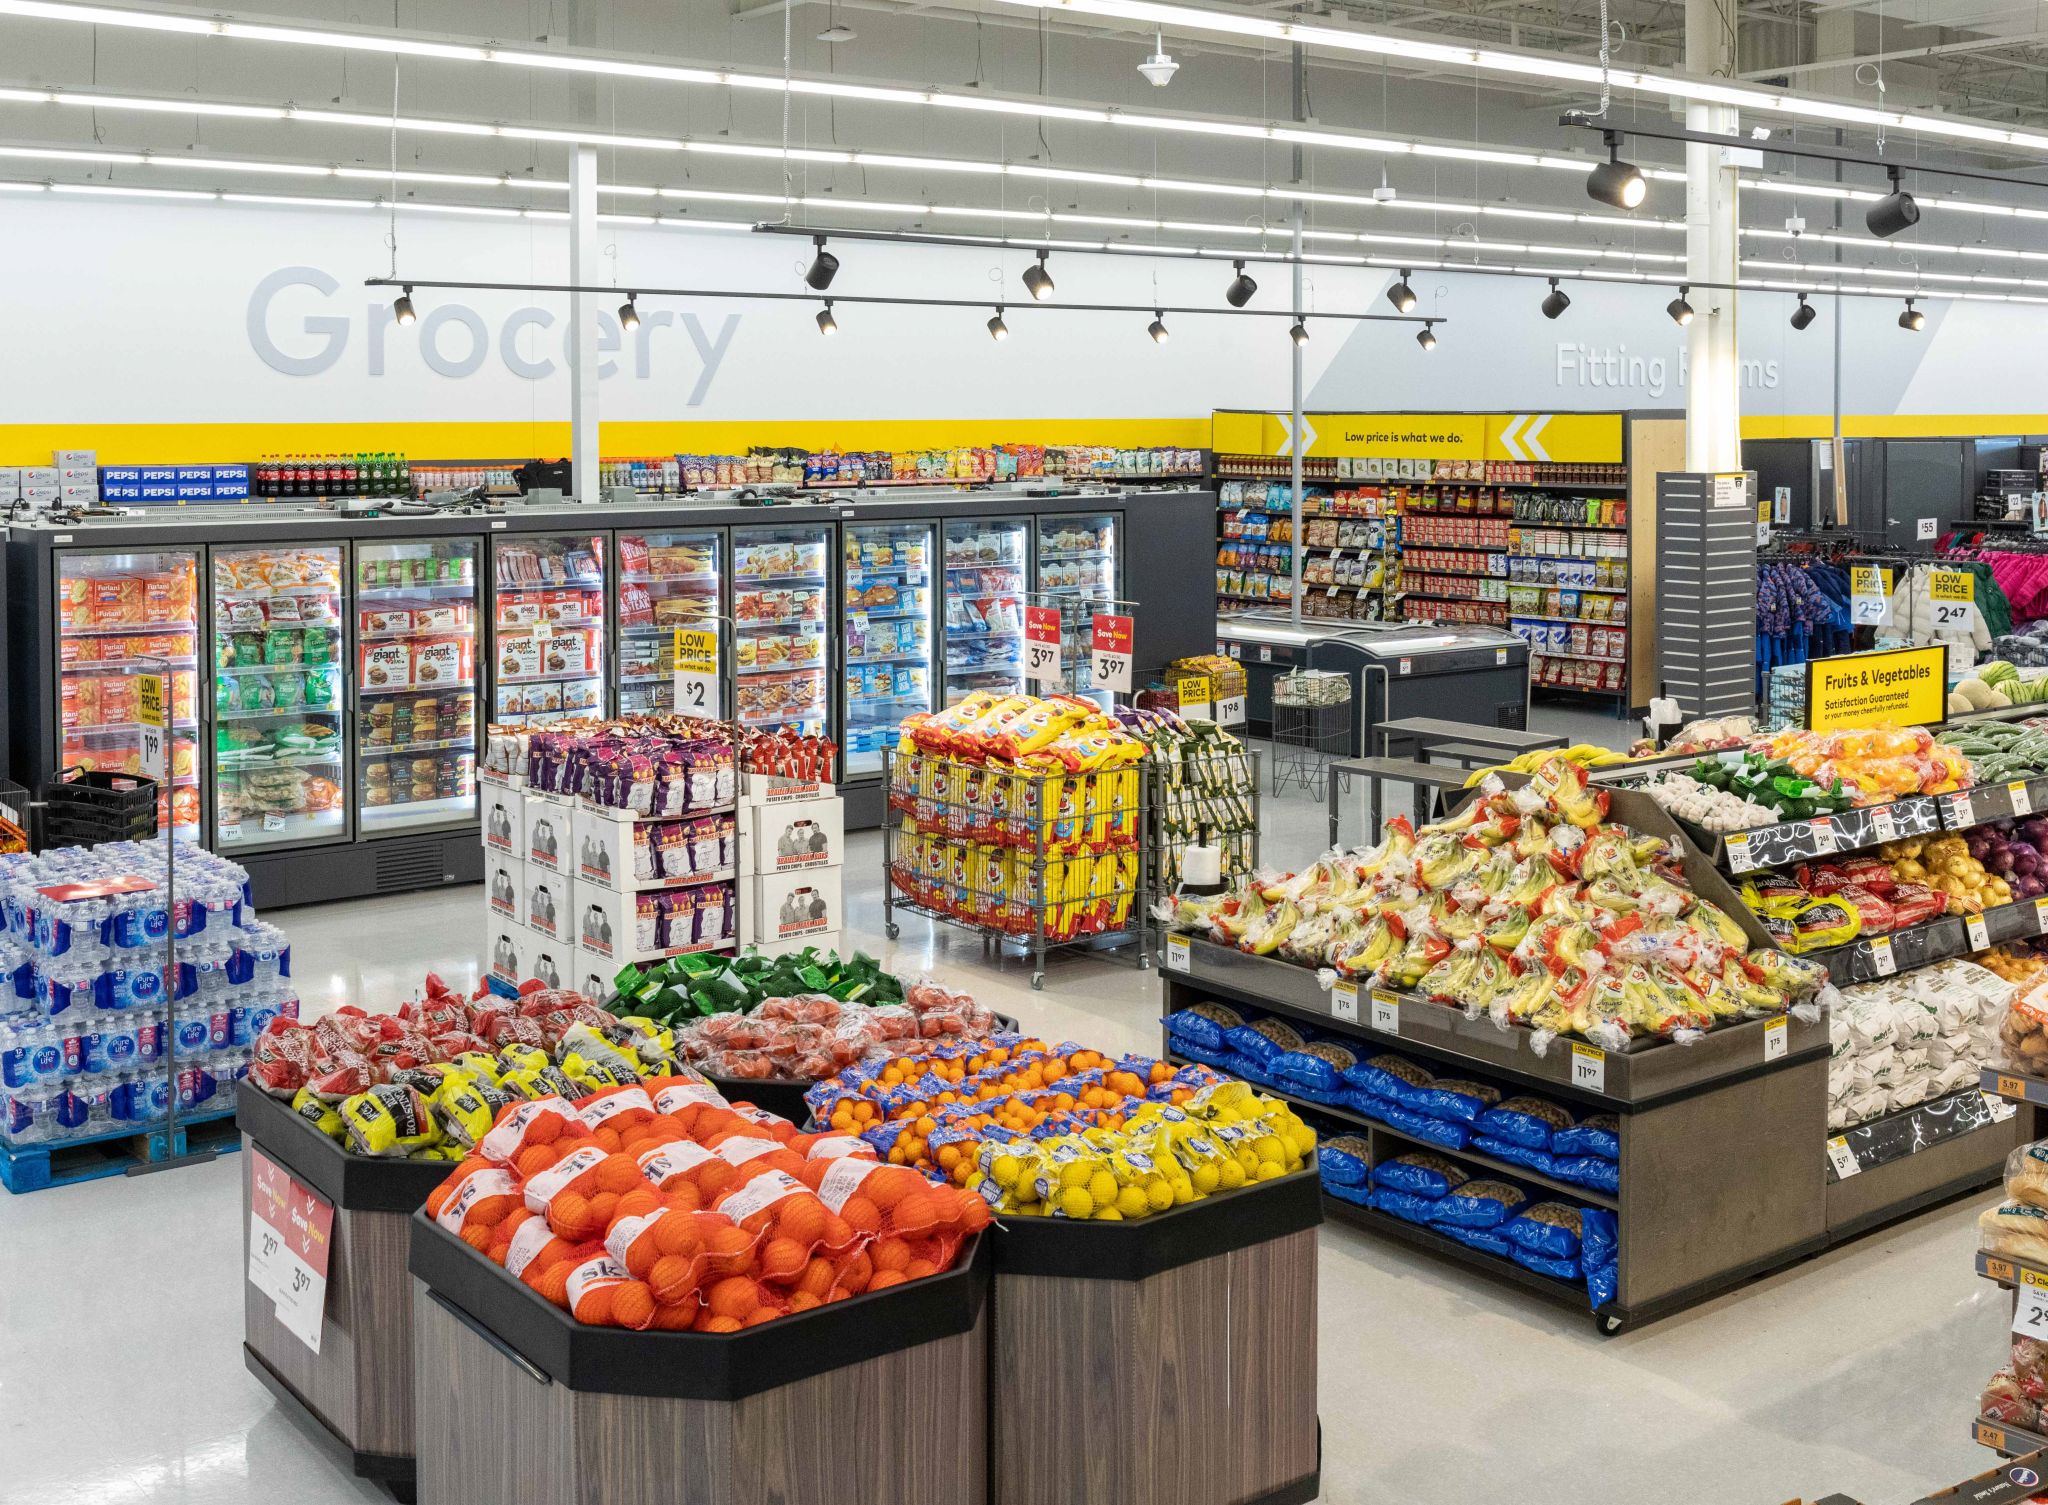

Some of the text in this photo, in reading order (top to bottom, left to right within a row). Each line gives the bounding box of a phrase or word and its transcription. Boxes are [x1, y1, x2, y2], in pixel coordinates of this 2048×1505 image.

[1556, 343, 1666, 397] Fitting
[1345, 431, 1463, 444] Low price is what we do.
[106, 471, 139, 480] PEPSI
[143, 471, 175, 480] PEPSI
[179, 471, 211, 479] PEPSI
[216, 470, 247, 479] PEPSI
[106, 488, 139, 497] PEPSI
[143, 488, 175, 497] PEPSI
[179, 487, 211, 496] PEPSI
[216, 486, 247, 496] PEPSI
[1921, 522, 1934, 533] $55
[1935, 574, 1962, 584] LOW
[1935, 584, 1968, 594] PRICE
[1938, 606, 1967, 623] 247
[1043, 622, 1056, 631] Now
[1113, 630, 1127, 639] Now
[551, 636, 577, 650] giant
[679, 633, 705, 648] LOW
[507, 639, 531, 653] giant
[373, 648, 400, 662] giant
[424, 645, 451, 660] giant
[679, 647, 712, 663] PRICE
[684, 663, 697, 671] what
[1825, 663, 1931, 691] Fruits & Vegetables
[142, 678, 156, 694] LOW
[1182, 680, 1201, 690] LOW
[686, 681, 705, 707] $2
[1183, 688, 1206, 698] PRICE
[142, 695, 160, 711] PRICE
[1824, 689, 1909, 710] Satisfaction Guaranteed
[1222, 702, 1239, 719] 198
[1831, 712, 1842, 720] your
[1860, 704, 1885, 715] cheerfully
[1885, 702, 1910, 711] refunded.
[145, 734, 158, 763] 199
[149, 914, 165, 923] Pure
[151, 919, 163, 927] Life
[137, 975, 154, 984] Pure
[140, 982, 152, 990] Life
[185, 1026, 202, 1035] Pure
[113, 1039, 129, 1048] Pure
[115, 1045, 127, 1053] Life
[1575, 1045, 1603, 1057] LOW PRICE
[38, 1050, 55, 1059] Pure
[40, 1056, 54, 1064] Life
[2003, 1079, 2018, 1090] 5.97
[395, 1086, 416, 1135] ROASTING
[257, 1174, 272, 1199] Save
[292, 1206, 325, 1245] Save Now
[1992, 1262, 2007, 1272] 3.97
[1983, 1429, 1998, 1440] 2.47
